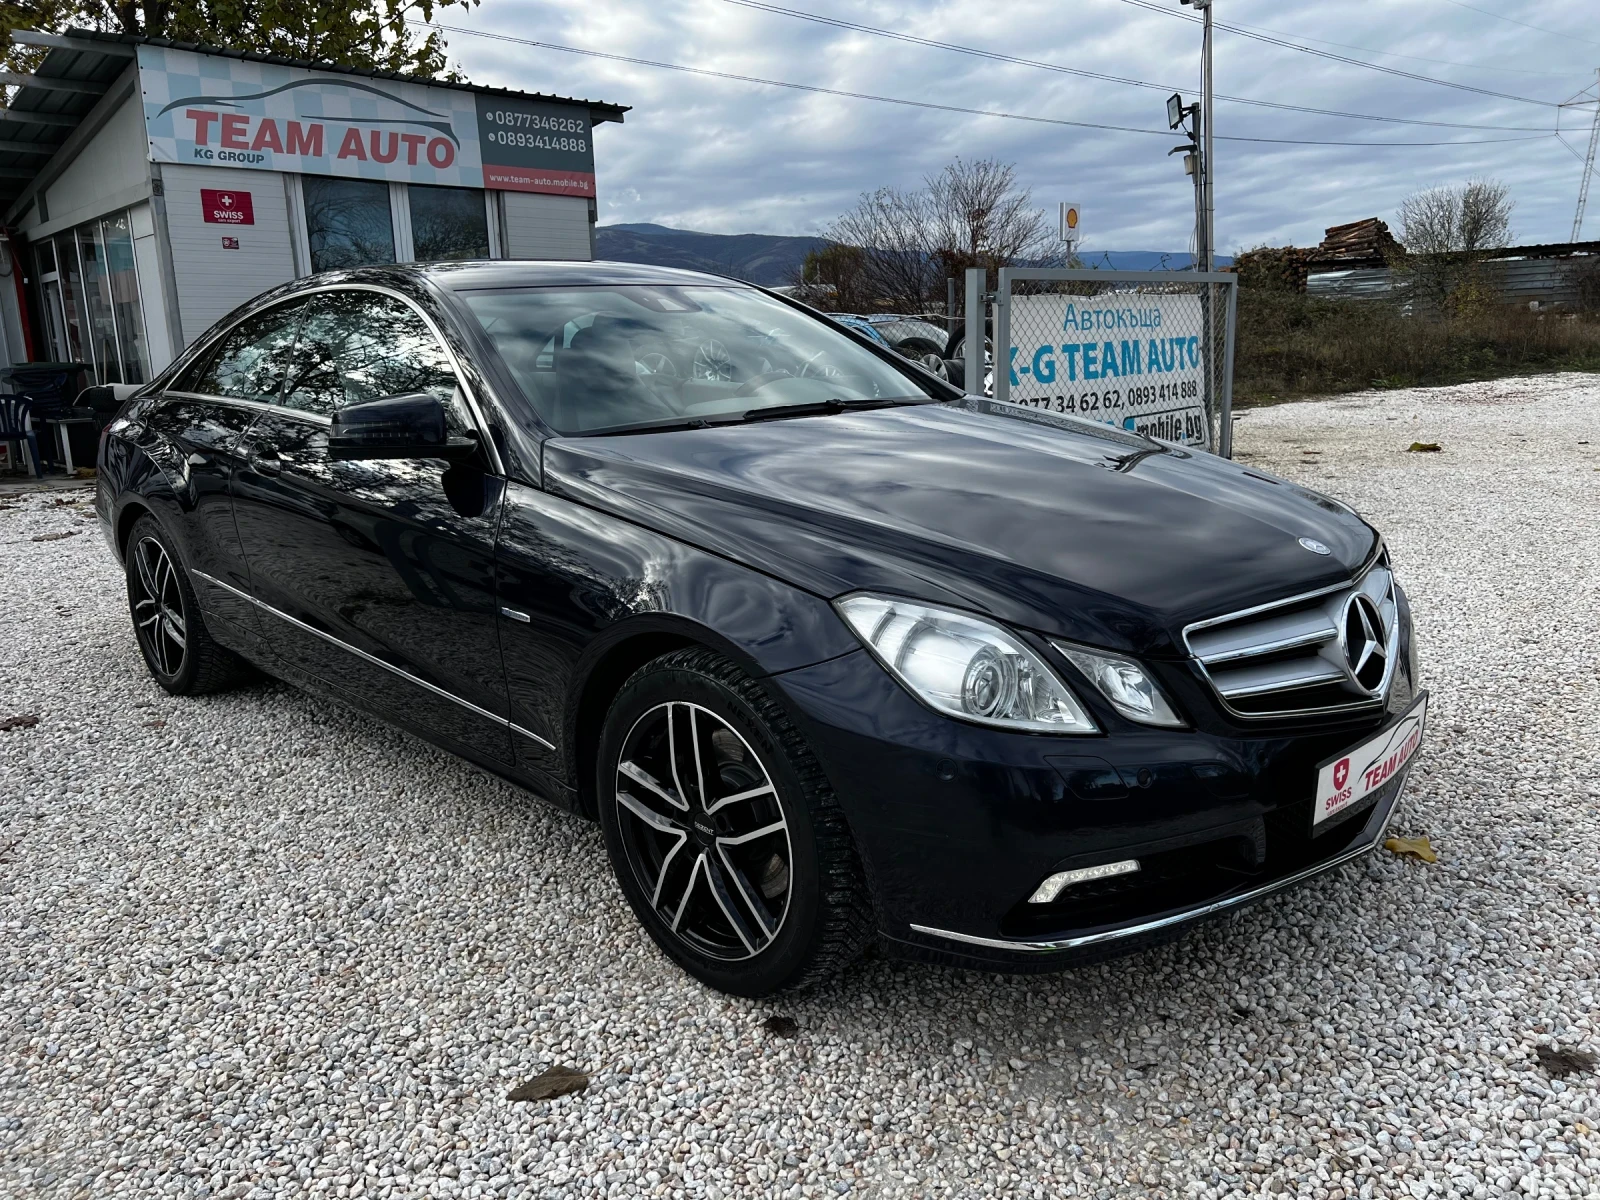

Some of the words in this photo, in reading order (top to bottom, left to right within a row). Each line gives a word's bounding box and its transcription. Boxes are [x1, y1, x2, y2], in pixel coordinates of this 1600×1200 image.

[495, 111, 584, 133] 0877346262
[186, 109, 323, 157] TEAM
[337, 128, 455, 169] AUTO
[497, 131, 587, 153] 0893414888
[194, 148, 214, 160] KG
[217, 150, 265, 164] GROUP
[489, 174, 589, 190] www.team-auto.mobile.bg
[213, 210, 244, 220] SWISS
[1063, 303, 1161, 333] Автокъща
[1061, 339, 1142, 382] TEAM
[1147, 335, 1199, 374] AUTO
[1010, 397, 1050, 410] 77
[1056, 395, 1076, 413] 34
[1080, 391, 1099, 412] 62
[1102, 389, 1125, 410] 62,
[1127, 386, 1156, 407] 0893
[1159, 383, 1179, 402] 414
[1180, 380, 1198, 399] 888
[727, 701, 773, 754] NEXEN
[1365, 751, 1398, 792] TEAM
[1397, 729, 1419, 768] AUTO
[1325, 786, 1352, 810] SWISS
